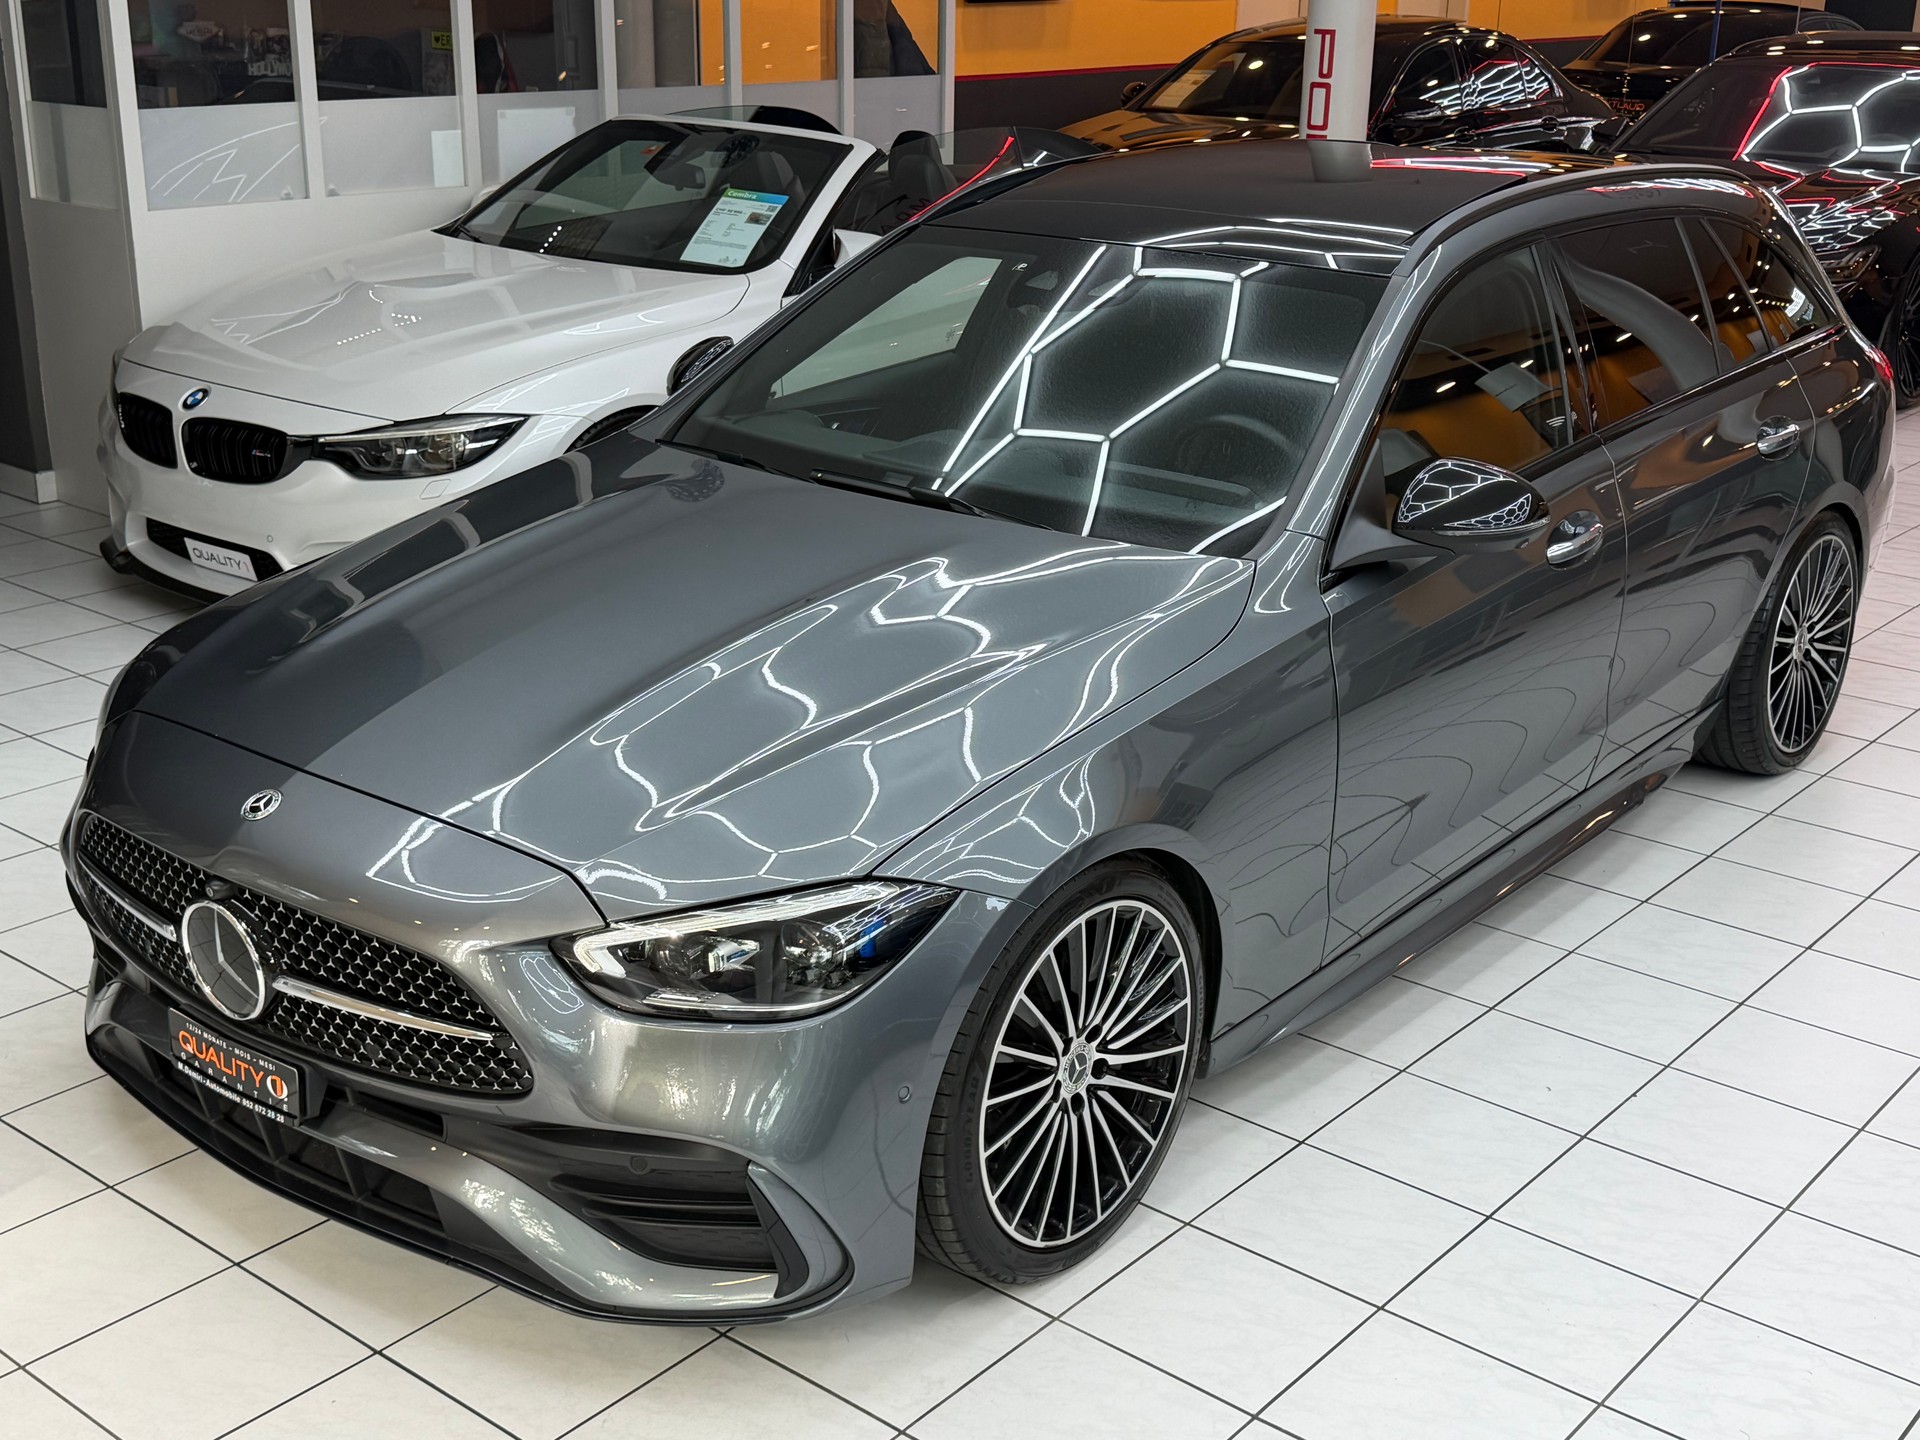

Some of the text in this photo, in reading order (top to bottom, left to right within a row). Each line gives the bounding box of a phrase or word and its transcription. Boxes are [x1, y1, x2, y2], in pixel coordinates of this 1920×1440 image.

[1306, 29, 1336, 140] PO
[727, 190, 758, 200] Cembra
[192, 547, 242, 570] QUALITY
[178, 1030, 264, 1088] QUALITY
[203, 1032, 227, 1049] MONATE
[234, 1048, 251, 1061] MOIS
[259, 1059, 276, 1072] MESI
[181, 1052, 288, 1112] GARANTIE
[267, 1109, 276, 1119] 28
[276, 1113, 285, 1123] 28
